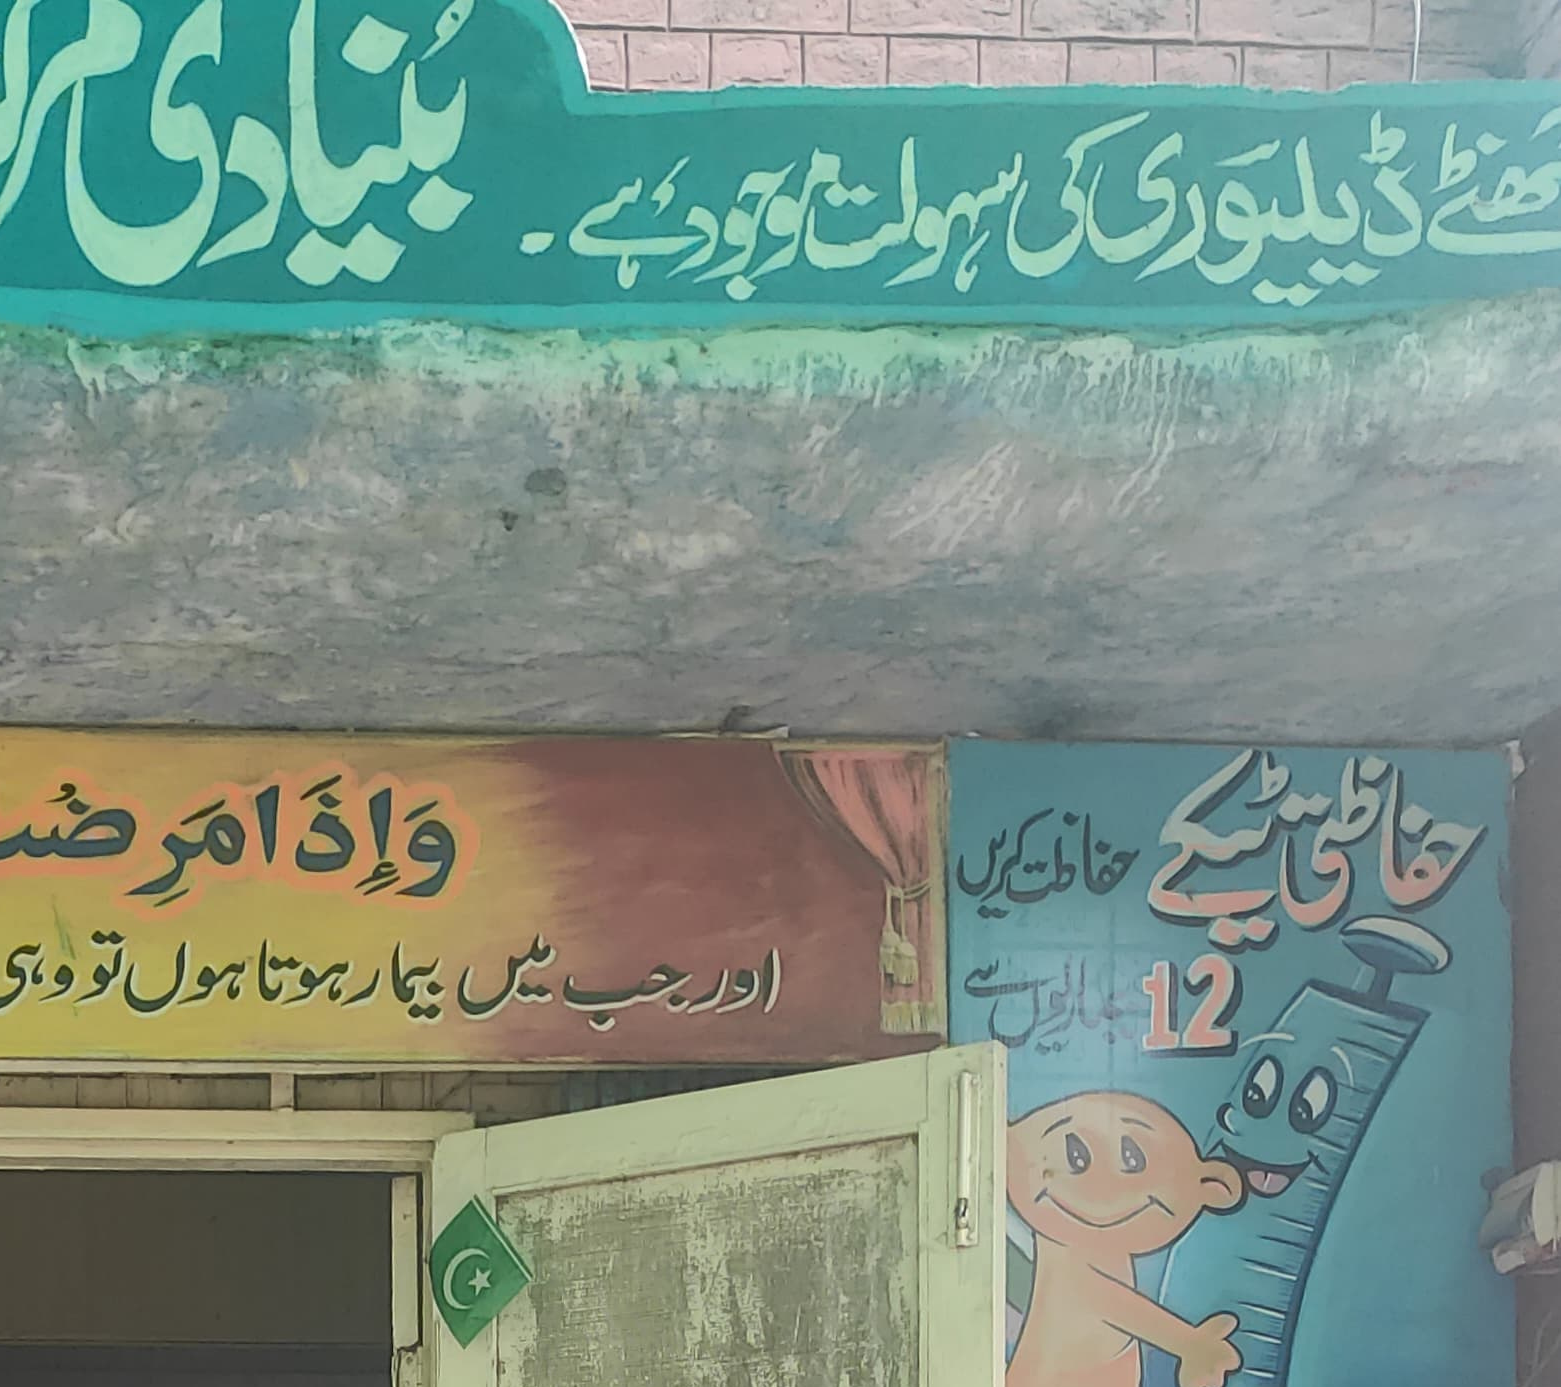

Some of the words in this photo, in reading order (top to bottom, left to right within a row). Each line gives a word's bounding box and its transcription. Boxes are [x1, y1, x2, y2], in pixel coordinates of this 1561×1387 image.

[804, 136, 1023, 293] سہولت
[1006, 110, 1150, 279] کی
[956, 807, 1055, 919] کریں
[1006, 809, 1140, 904] حفاظت
[73, 930, 126, 1008] تو
[122, 941, 246, 1019] ہوں
[257, 938, 355, 1007] ہوتا
[340, 940, 445, 1024] بیمار
[457, 931, 556, 1021] میں
[562, 961, 693, 1032] جب
[686, 946, 782, 1015] اور
[964, 958, 1058, 997] سے
[1142, 953, 1241, 1056] 12
